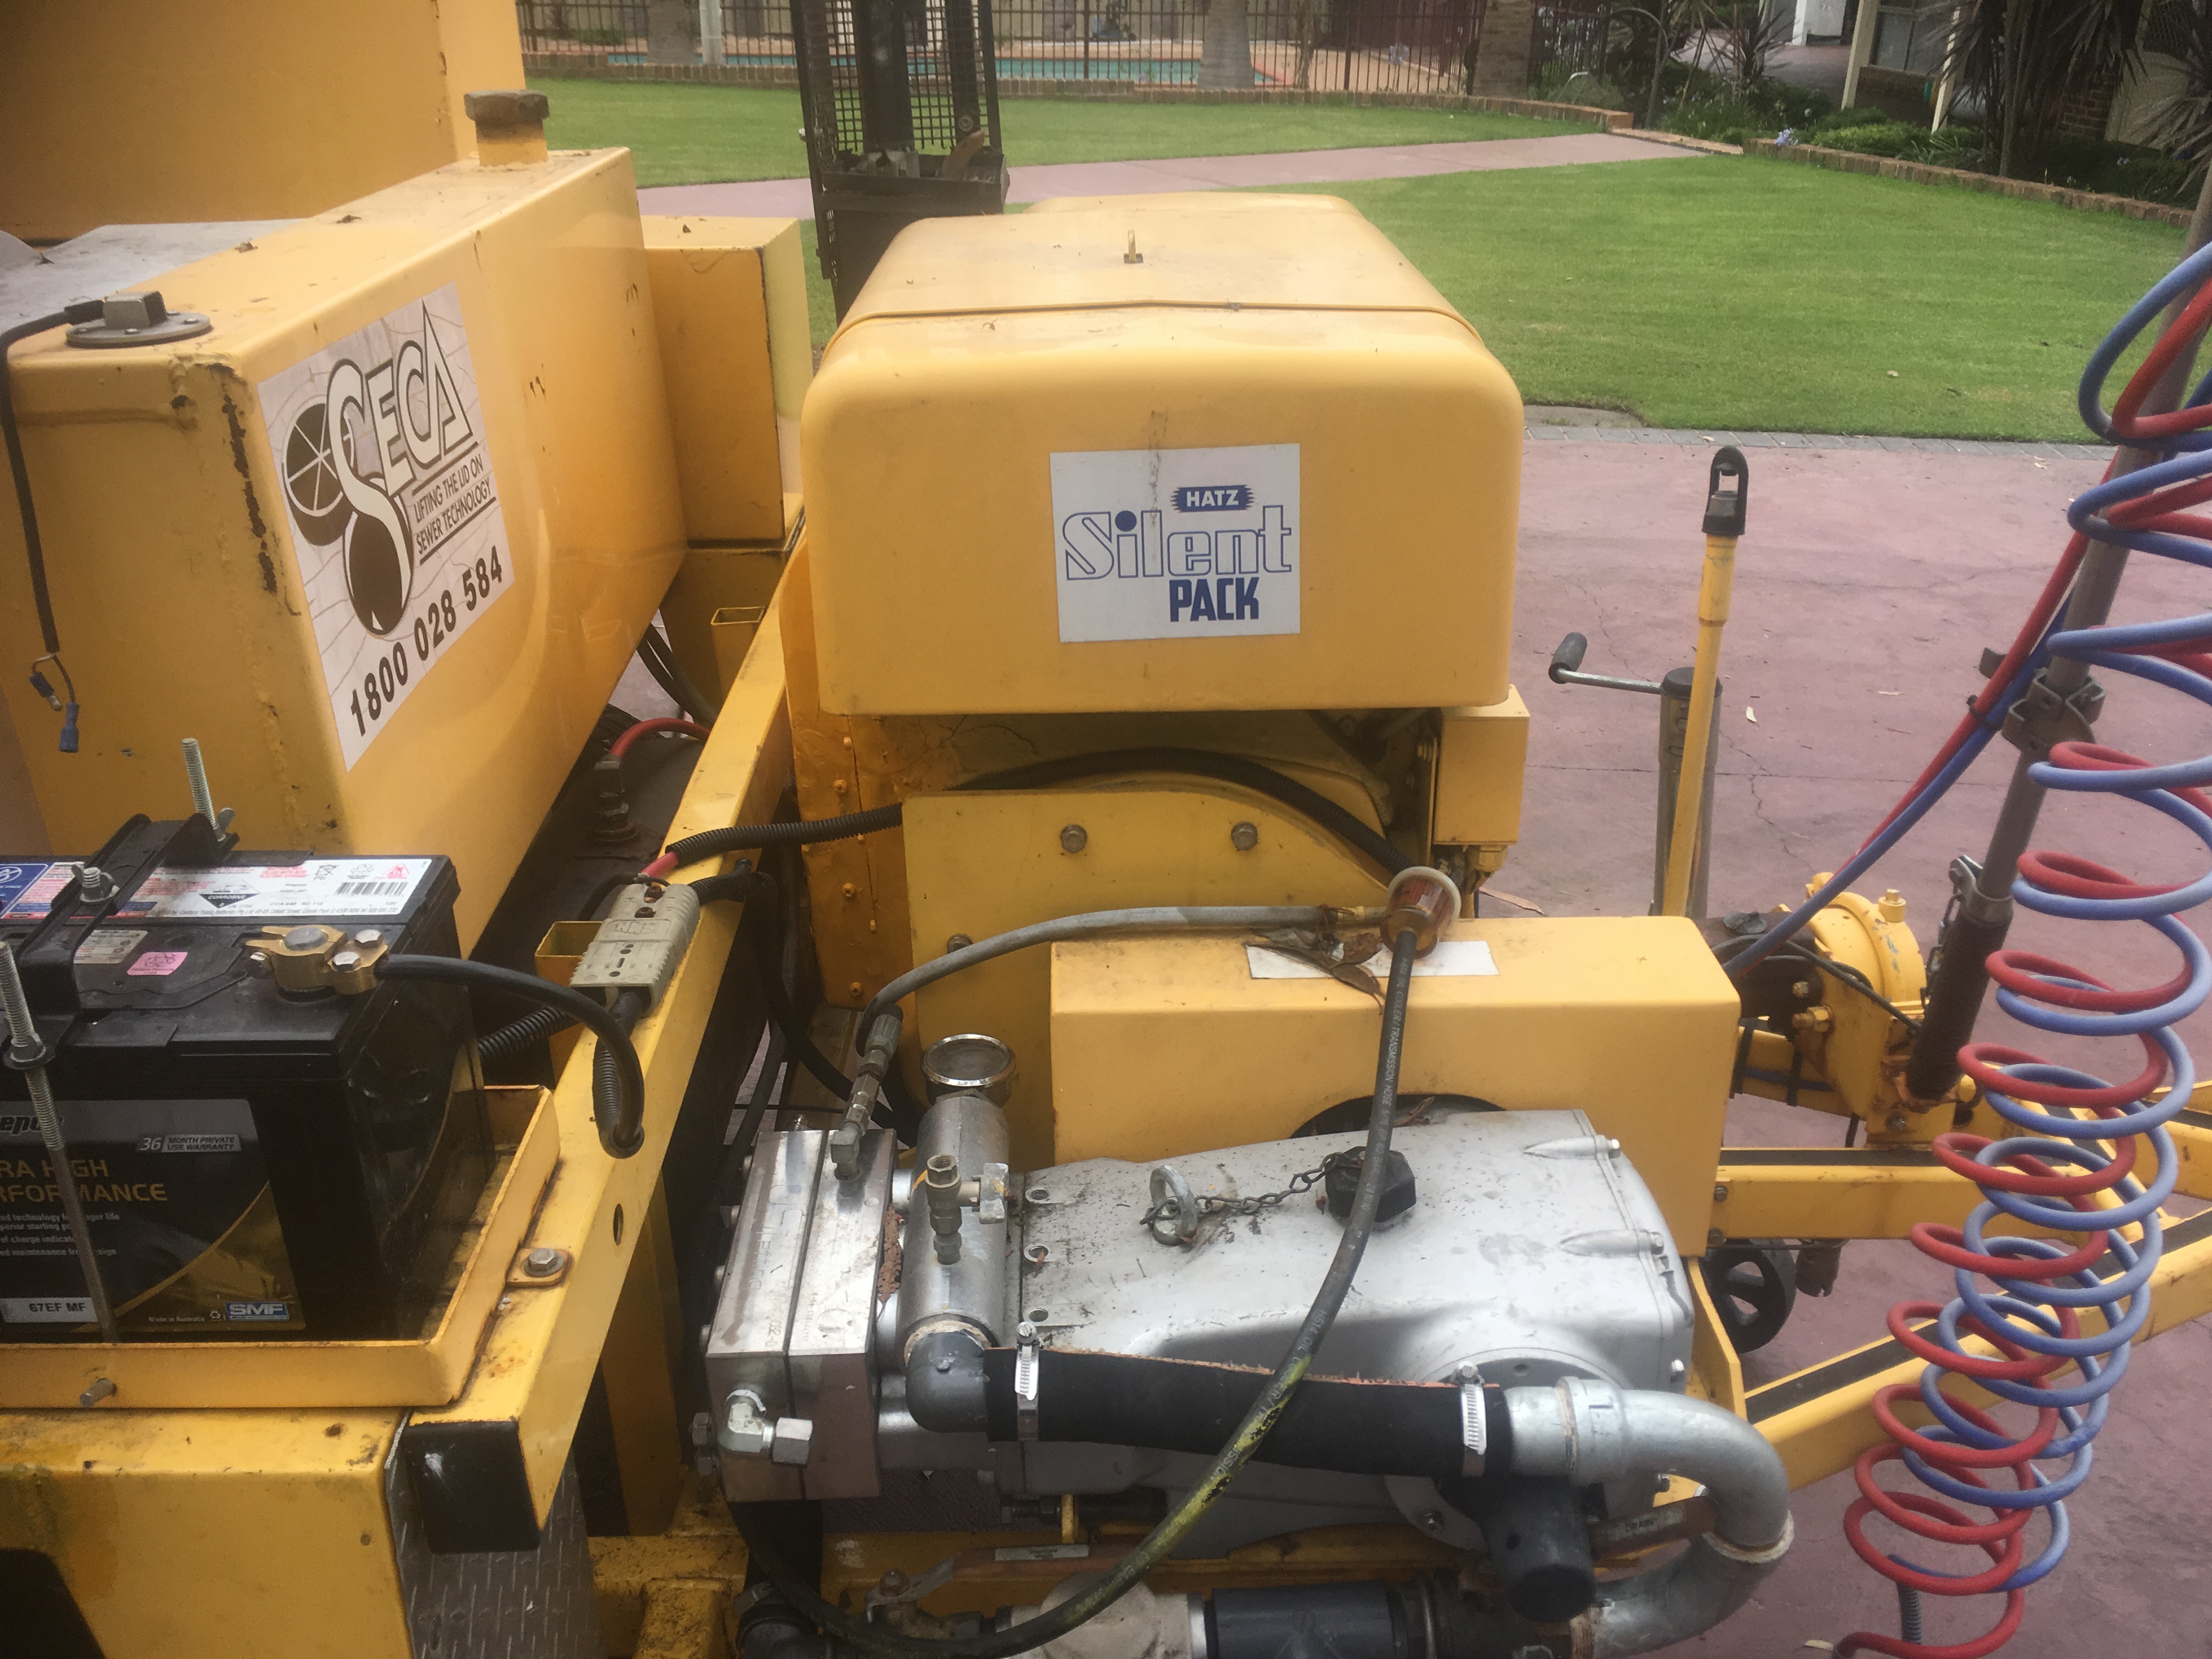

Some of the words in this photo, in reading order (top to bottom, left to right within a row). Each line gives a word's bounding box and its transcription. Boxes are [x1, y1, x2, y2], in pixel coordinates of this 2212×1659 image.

[326, 300, 473, 608] SECA
[414, 485, 443, 523] LIFTING
[442, 472, 459, 499] THE
[458, 465, 470, 488] LID
[470, 453, 483, 477] ON
[1187, 489, 1239, 507] HATZ
[416, 517, 443, 555] SEWER
[442, 477, 491, 531] TECHNOLOGY
[1063, 505, 1291, 580] Silent
[1169, 577, 1259, 622] PACK
[351, 642, 408, 736] 1800
[414, 589, 456, 661] 028
[462, 545, 503, 611] 584
[1383, 1085, 1393, 1107] HOSE
[140, 1138, 162, 1150] 36
[10, 1235, 41, 1244] charge
[29, 1303, 63, 1312] 67EF
[66, 1302, 86, 1312] MF
[229, 1304, 283, 1315] SMF
[1297, 1337, 1313, 1351] OIL
